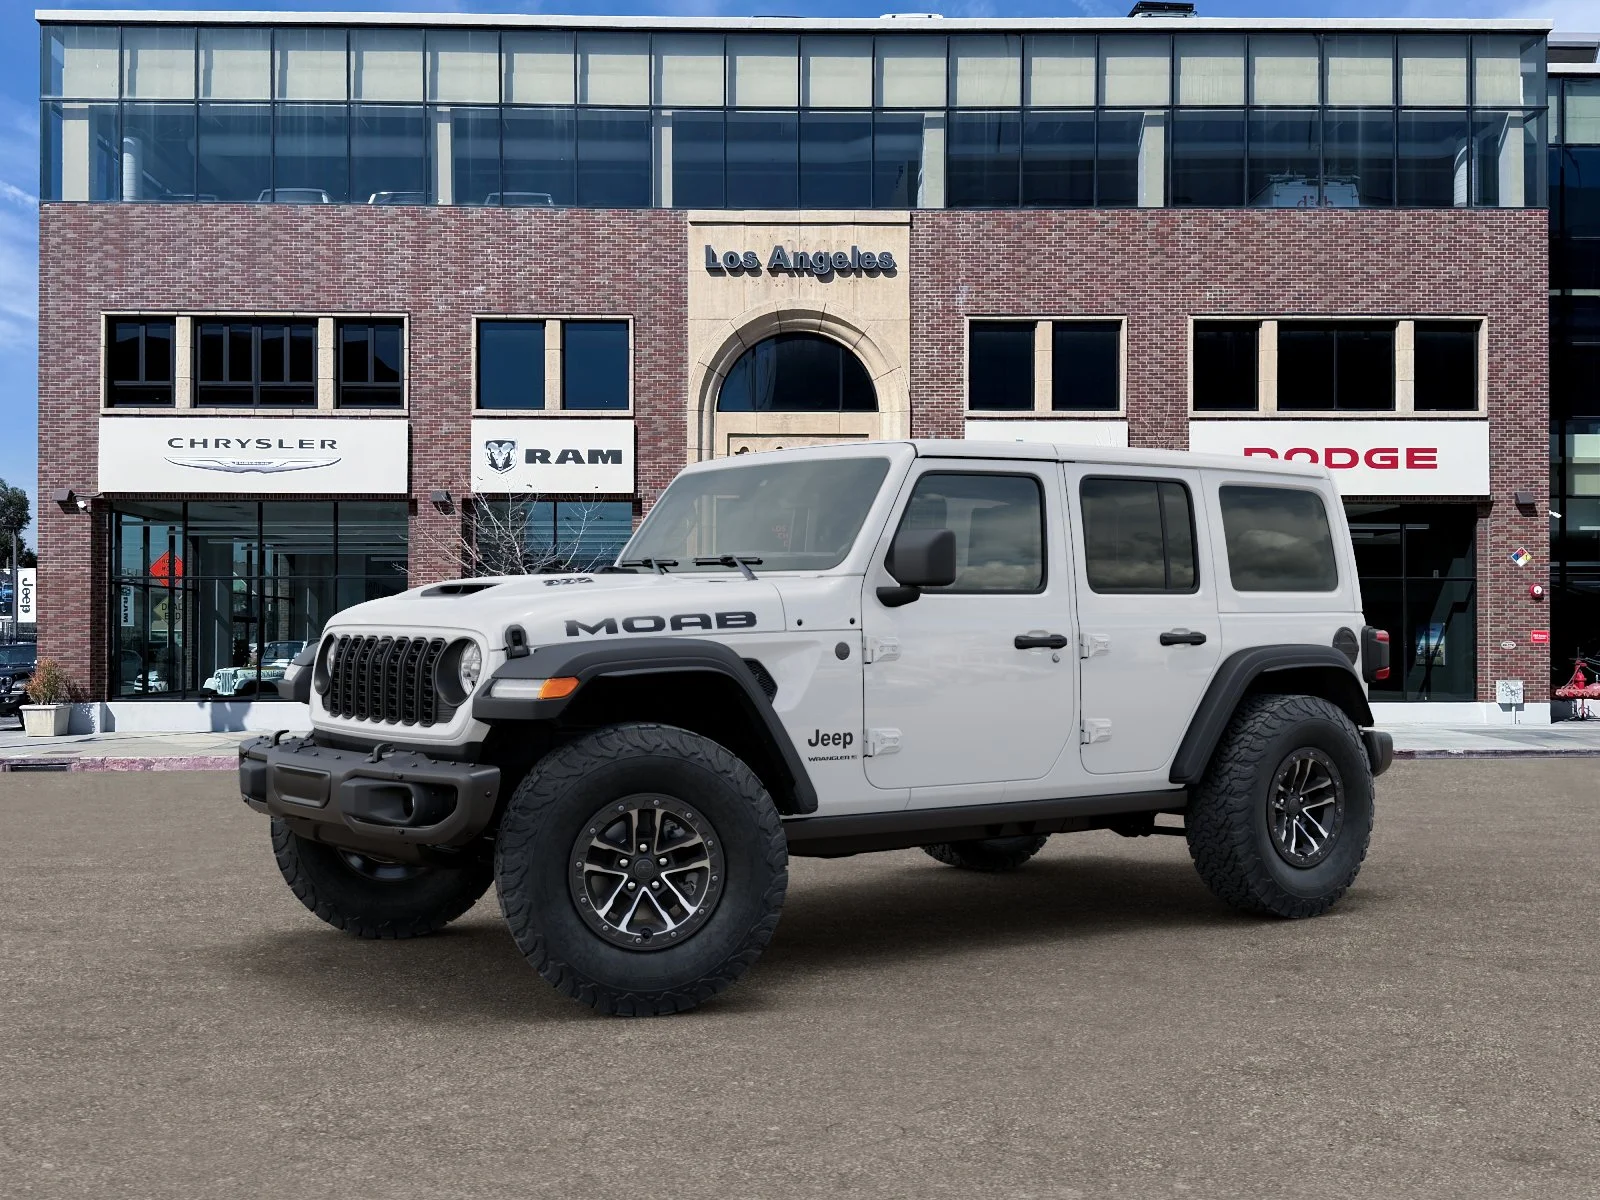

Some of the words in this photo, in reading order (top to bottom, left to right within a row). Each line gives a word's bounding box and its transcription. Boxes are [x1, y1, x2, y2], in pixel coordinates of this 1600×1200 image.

[704, 244, 758, 269] Los
[767, 244, 895, 275] Angeles
[167, 437, 338, 449] CHRYSLER
[525, 448, 622, 464] RAM
[20, 577, 34, 613] Jeep
[164, 612, 181, 620] ED
[564, 611, 757, 637] MOAB
[807, 729, 854, 749] Jeep
